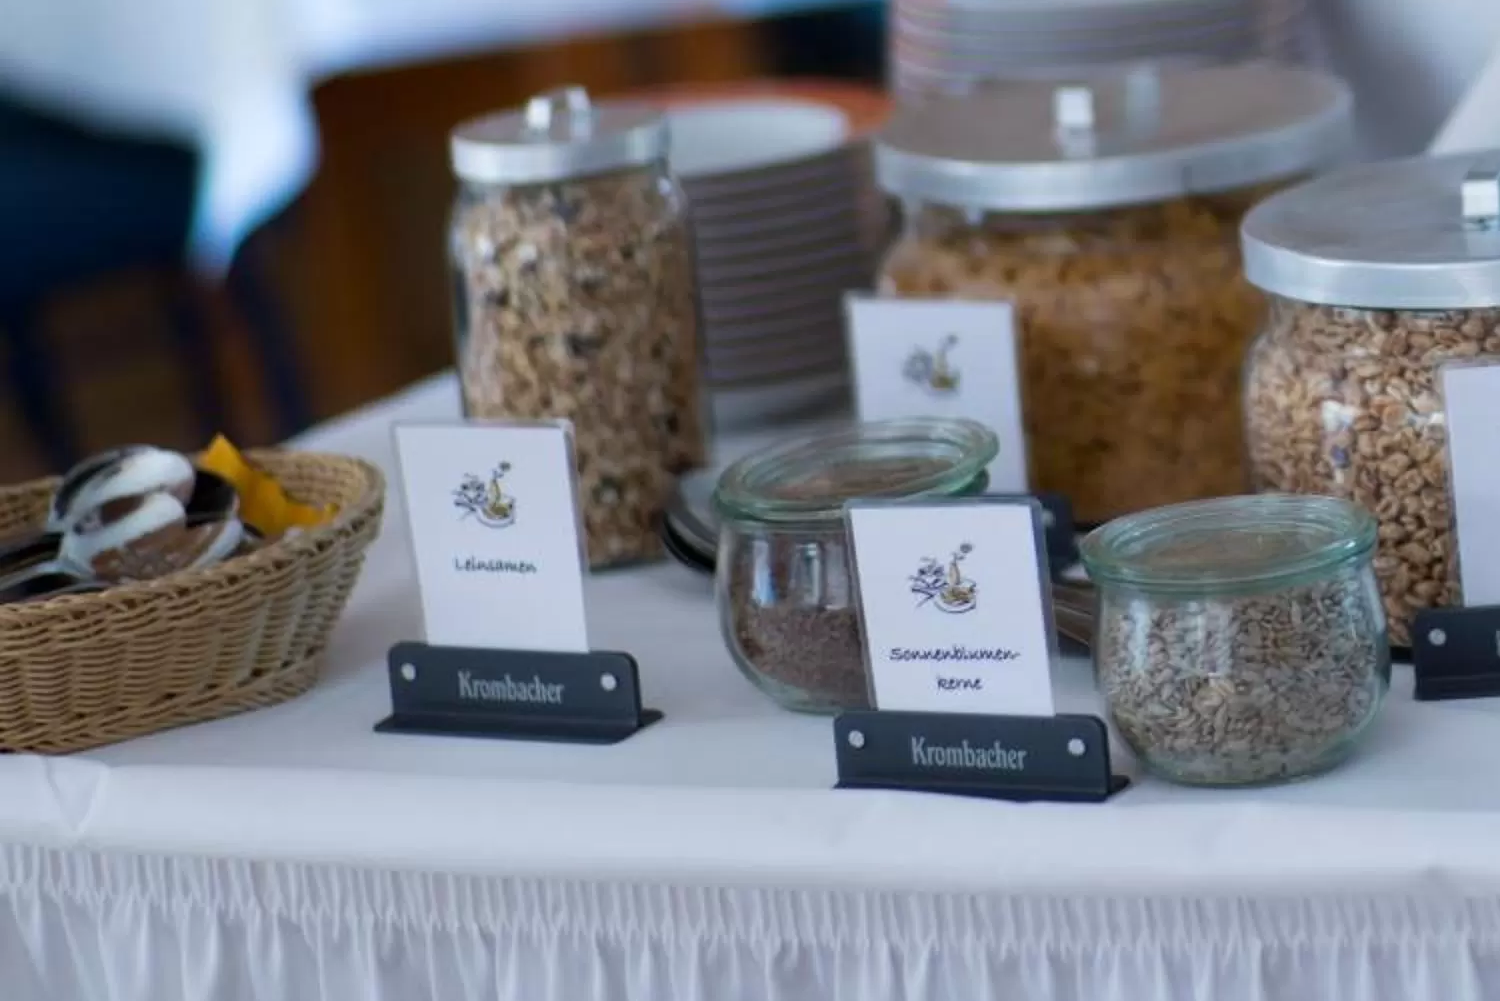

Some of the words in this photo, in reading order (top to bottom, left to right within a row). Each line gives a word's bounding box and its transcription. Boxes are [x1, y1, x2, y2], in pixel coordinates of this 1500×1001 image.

[455, 555, 537, 574] Leinsamen
[889, 645, 1021, 662] Sonnenblumen-
[458, 670, 564, 704] Krombacher
[936, 674, 983, 691] kerne
[911, 736, 1027, 772] Krombacher
